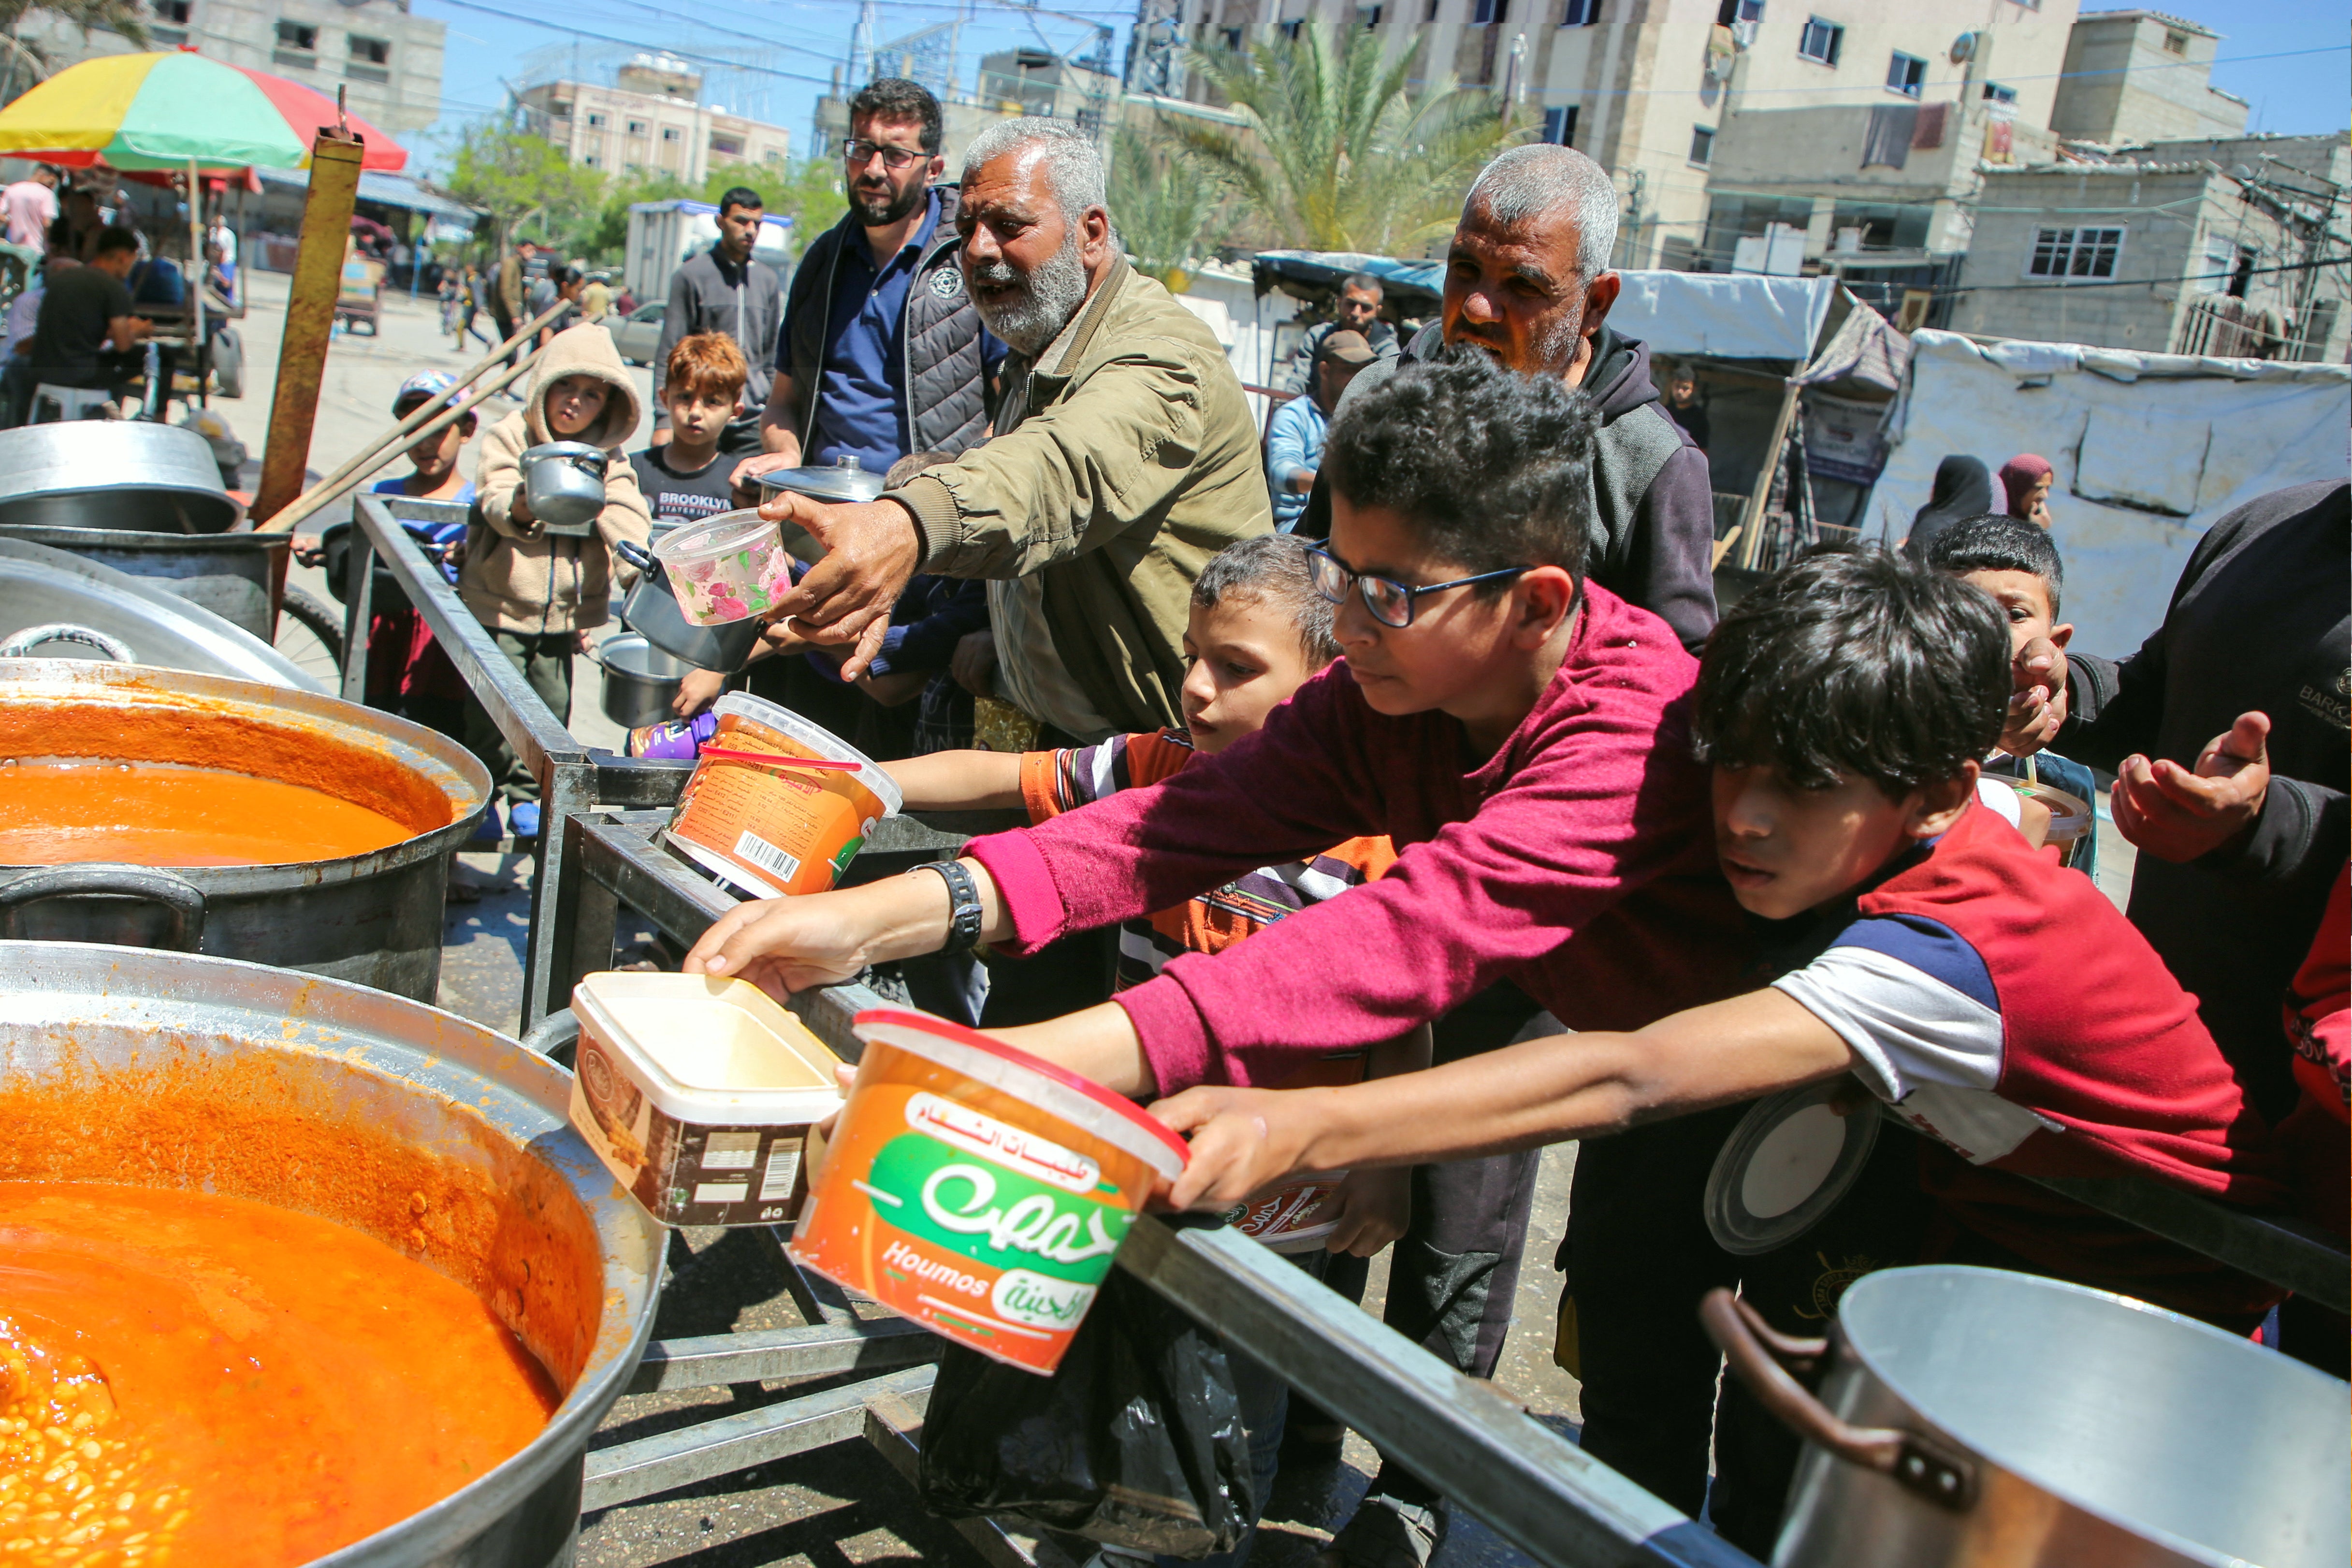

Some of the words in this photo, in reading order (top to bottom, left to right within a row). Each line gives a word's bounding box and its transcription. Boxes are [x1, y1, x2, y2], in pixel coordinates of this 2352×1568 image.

[660, 492, 732, 510] BROOKLYN
[660, 505, 695, 513] STATEN
[2299, 684, 2351, 720] BARK
[727, 742, 738, 750] 059
[779, 769, 815, 796] الأميرة
[915, 1105, 1002, 1145] الشام
[1003, 1136, 1091, 1179] طيبات
[922, 1163, 1120, 1264] حمص
[883, 1240, 990, 1298] Houmos
